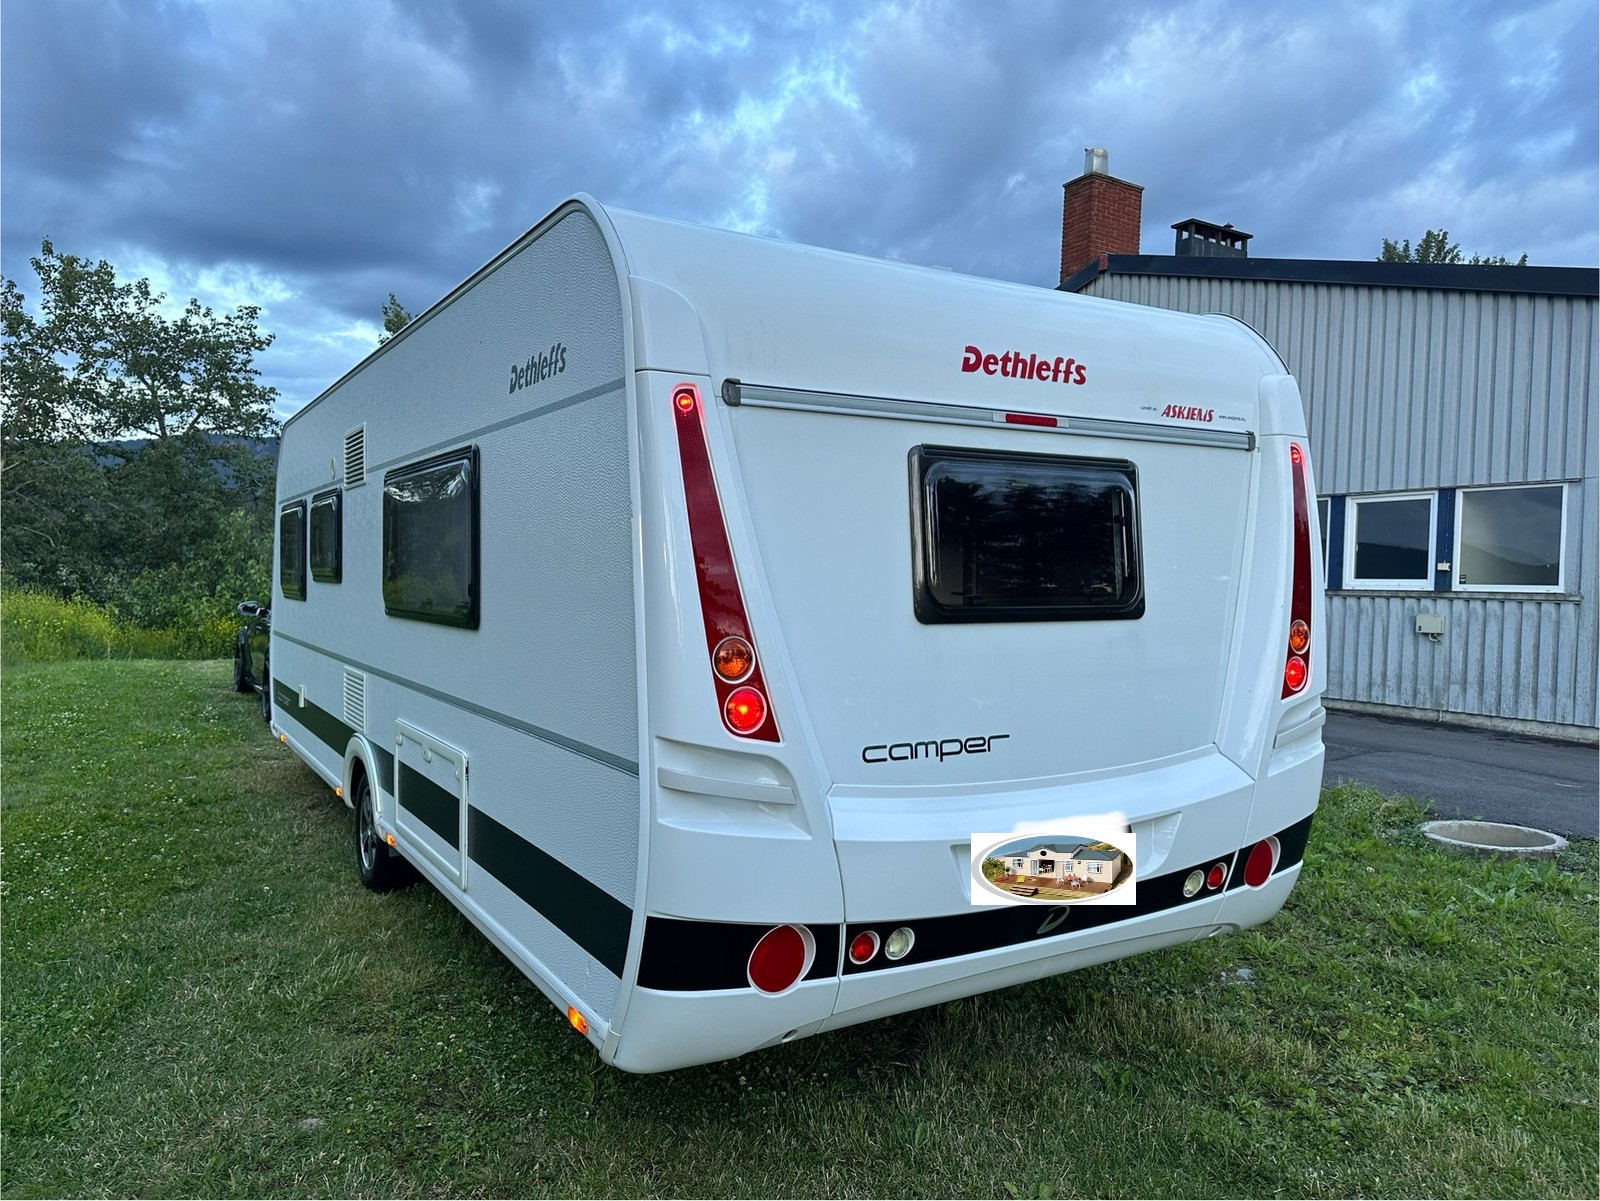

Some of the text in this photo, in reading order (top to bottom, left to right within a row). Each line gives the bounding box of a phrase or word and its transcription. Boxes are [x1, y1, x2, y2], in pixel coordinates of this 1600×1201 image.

[509, 342, 567, 394] Dethleffs
[961, 345, 1086, 385] Dethleffs
[862, 734, 1010, 763] camper
